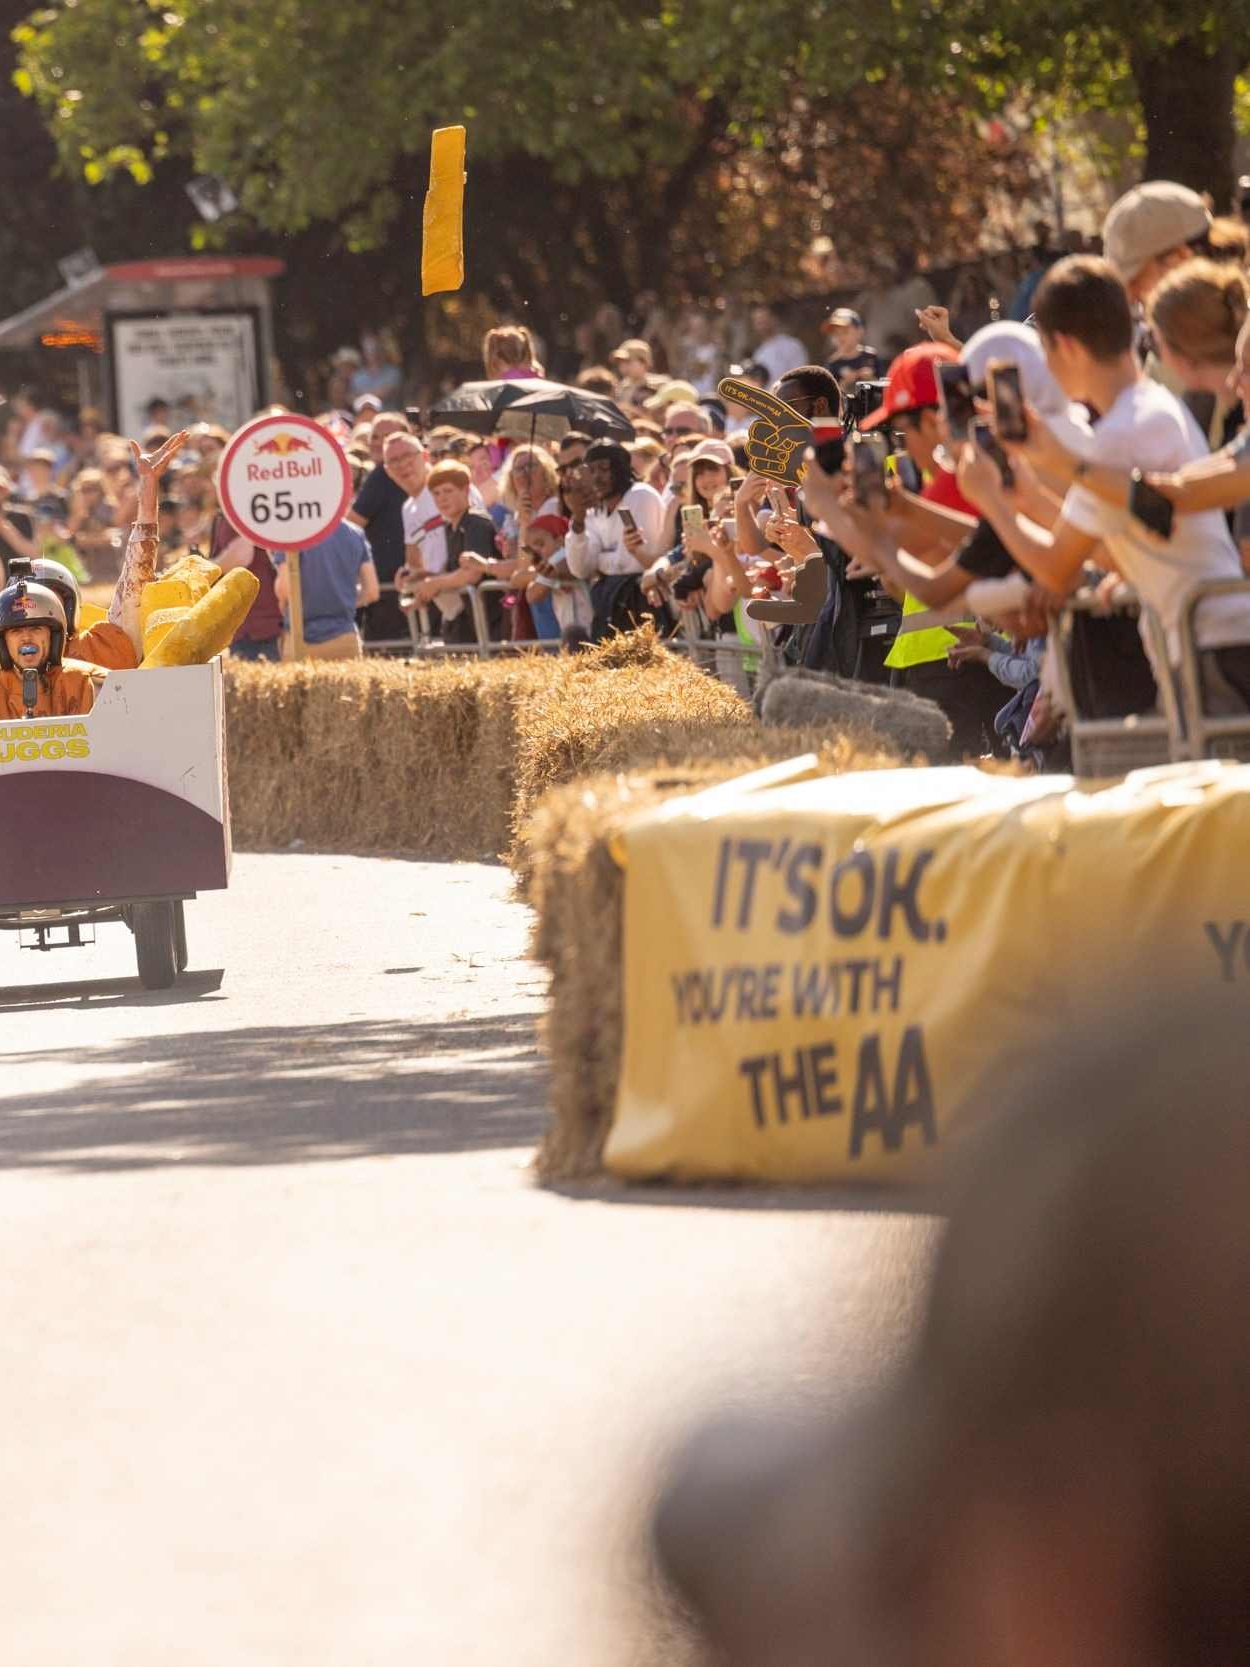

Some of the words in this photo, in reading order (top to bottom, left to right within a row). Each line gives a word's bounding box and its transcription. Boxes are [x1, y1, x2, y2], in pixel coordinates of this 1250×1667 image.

[247, 461, 284, 481] Red
[286, 457, 323, 478] Bull
[250, 491, 322, 524] 65m
[711, 838, 823, 936] IT'S
[829, 848, 947, 944] OK.
[1203, 919, 1250, 982] Y
[669, 962, 782, 1026] YOU'RE
[791, 953, 903, 1018] WITH
[739, 1040, 843, 1131] THE
[847, 1023, 939, 1163] AA
